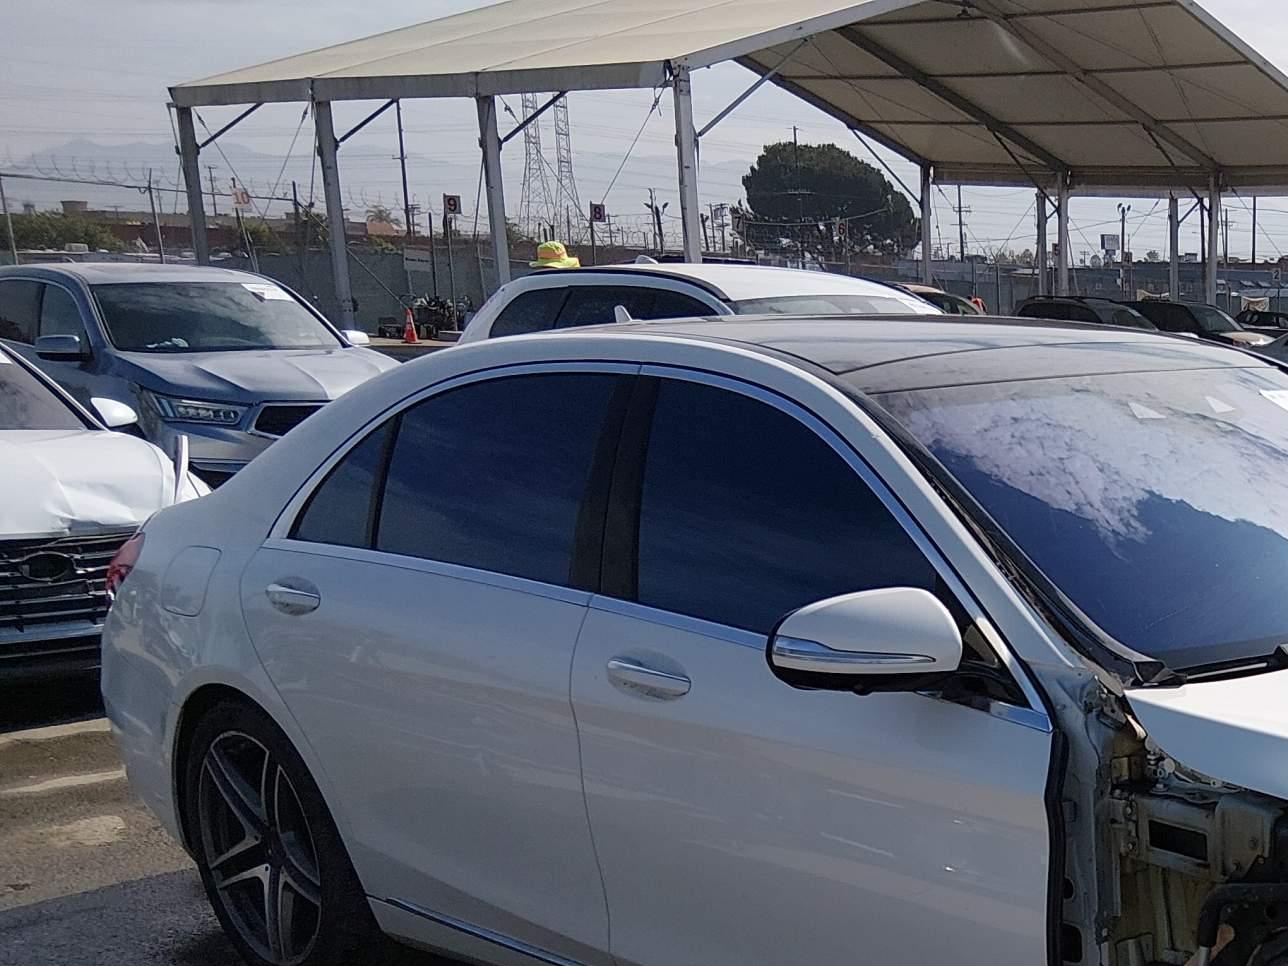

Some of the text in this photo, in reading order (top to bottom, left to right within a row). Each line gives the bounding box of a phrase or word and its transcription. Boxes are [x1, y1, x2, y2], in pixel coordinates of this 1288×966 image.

[232, 191, 250, 205] 10
[447, 197, 457, 212] 9
[593, 206, 602, 220] 8
[838, 222, 846, 235] 6
[1273, 269, 1280, 280] 2
